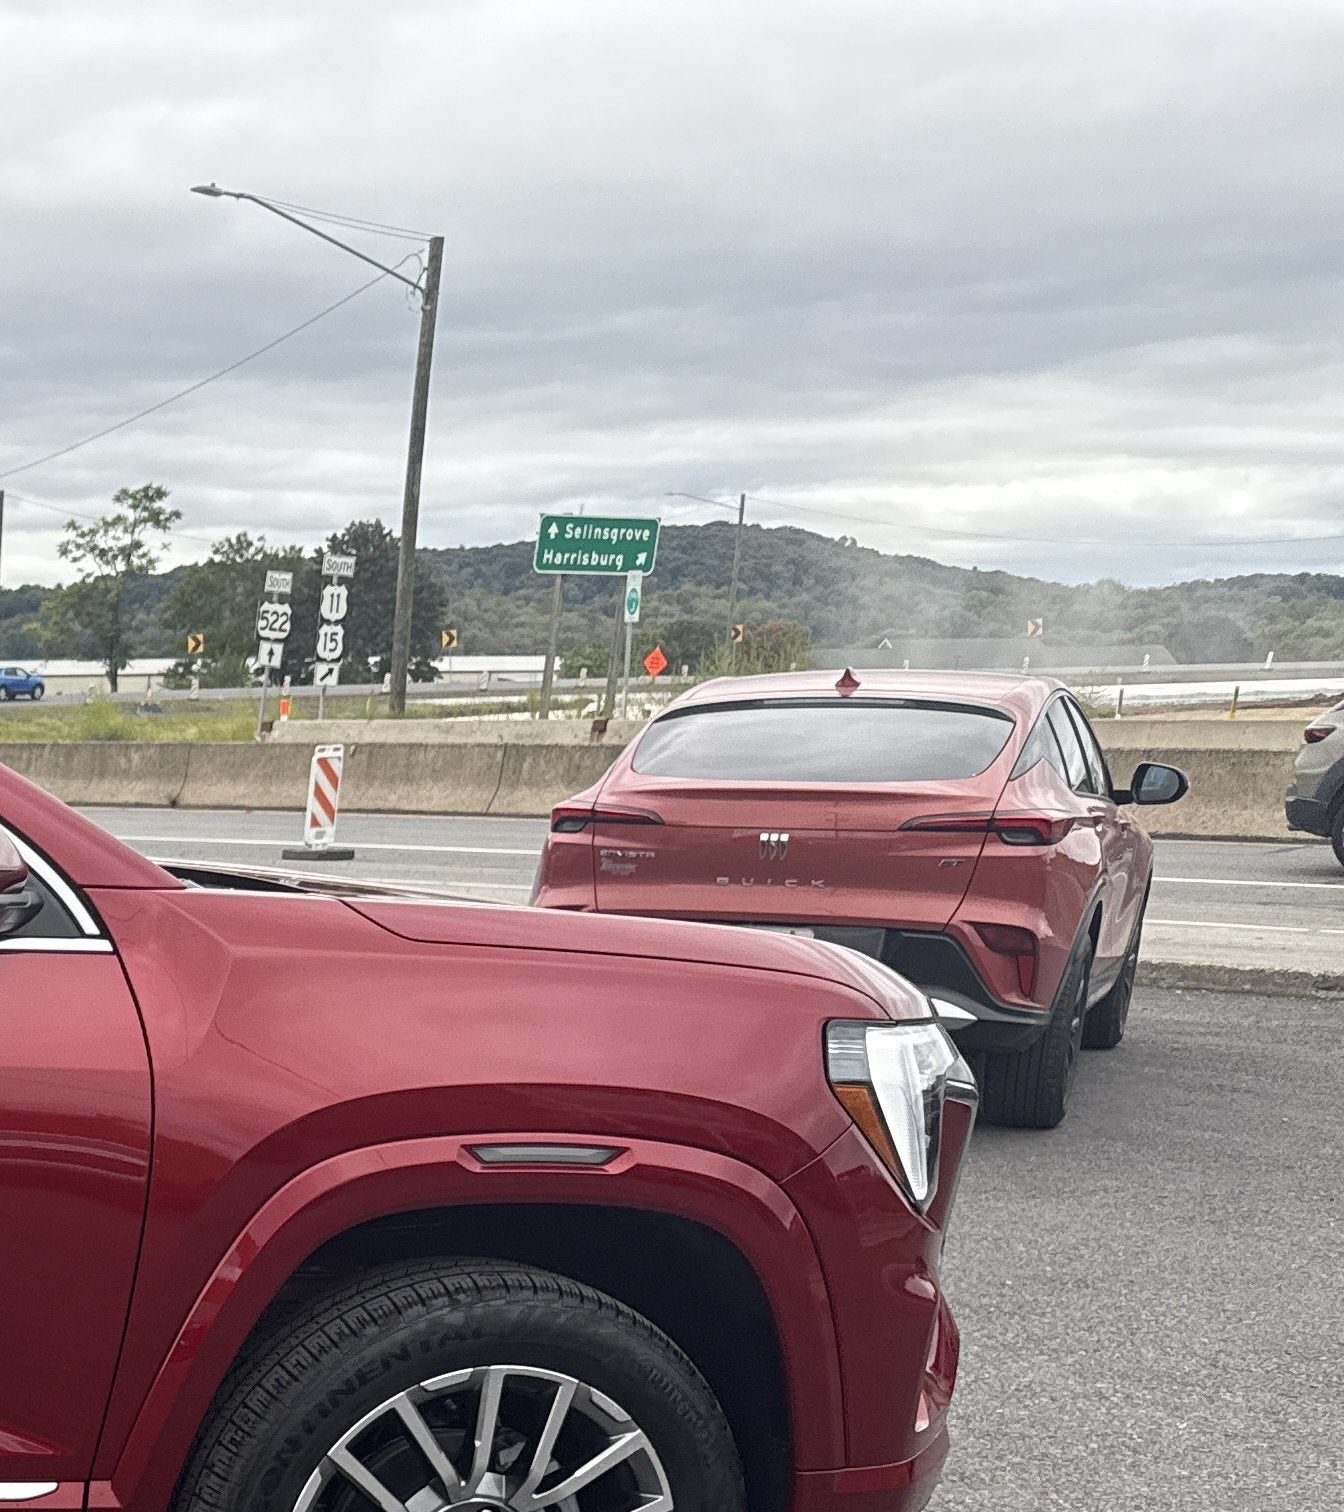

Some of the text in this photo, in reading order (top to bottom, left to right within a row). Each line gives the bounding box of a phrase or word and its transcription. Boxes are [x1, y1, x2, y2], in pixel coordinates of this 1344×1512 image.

[564, 523, 650, 545] Selinsgrove
[326, 559, 352, 573] SOUTH
[543, 549, 624, 571] Harrisburg
[267, 575, 290, 588] SOUTH
[330, 593, 341, 614] 11
[260, 610, 289, 633] 522
[323, 632, 339, 653] 15
[716, 876, 825, 888] BUICK
